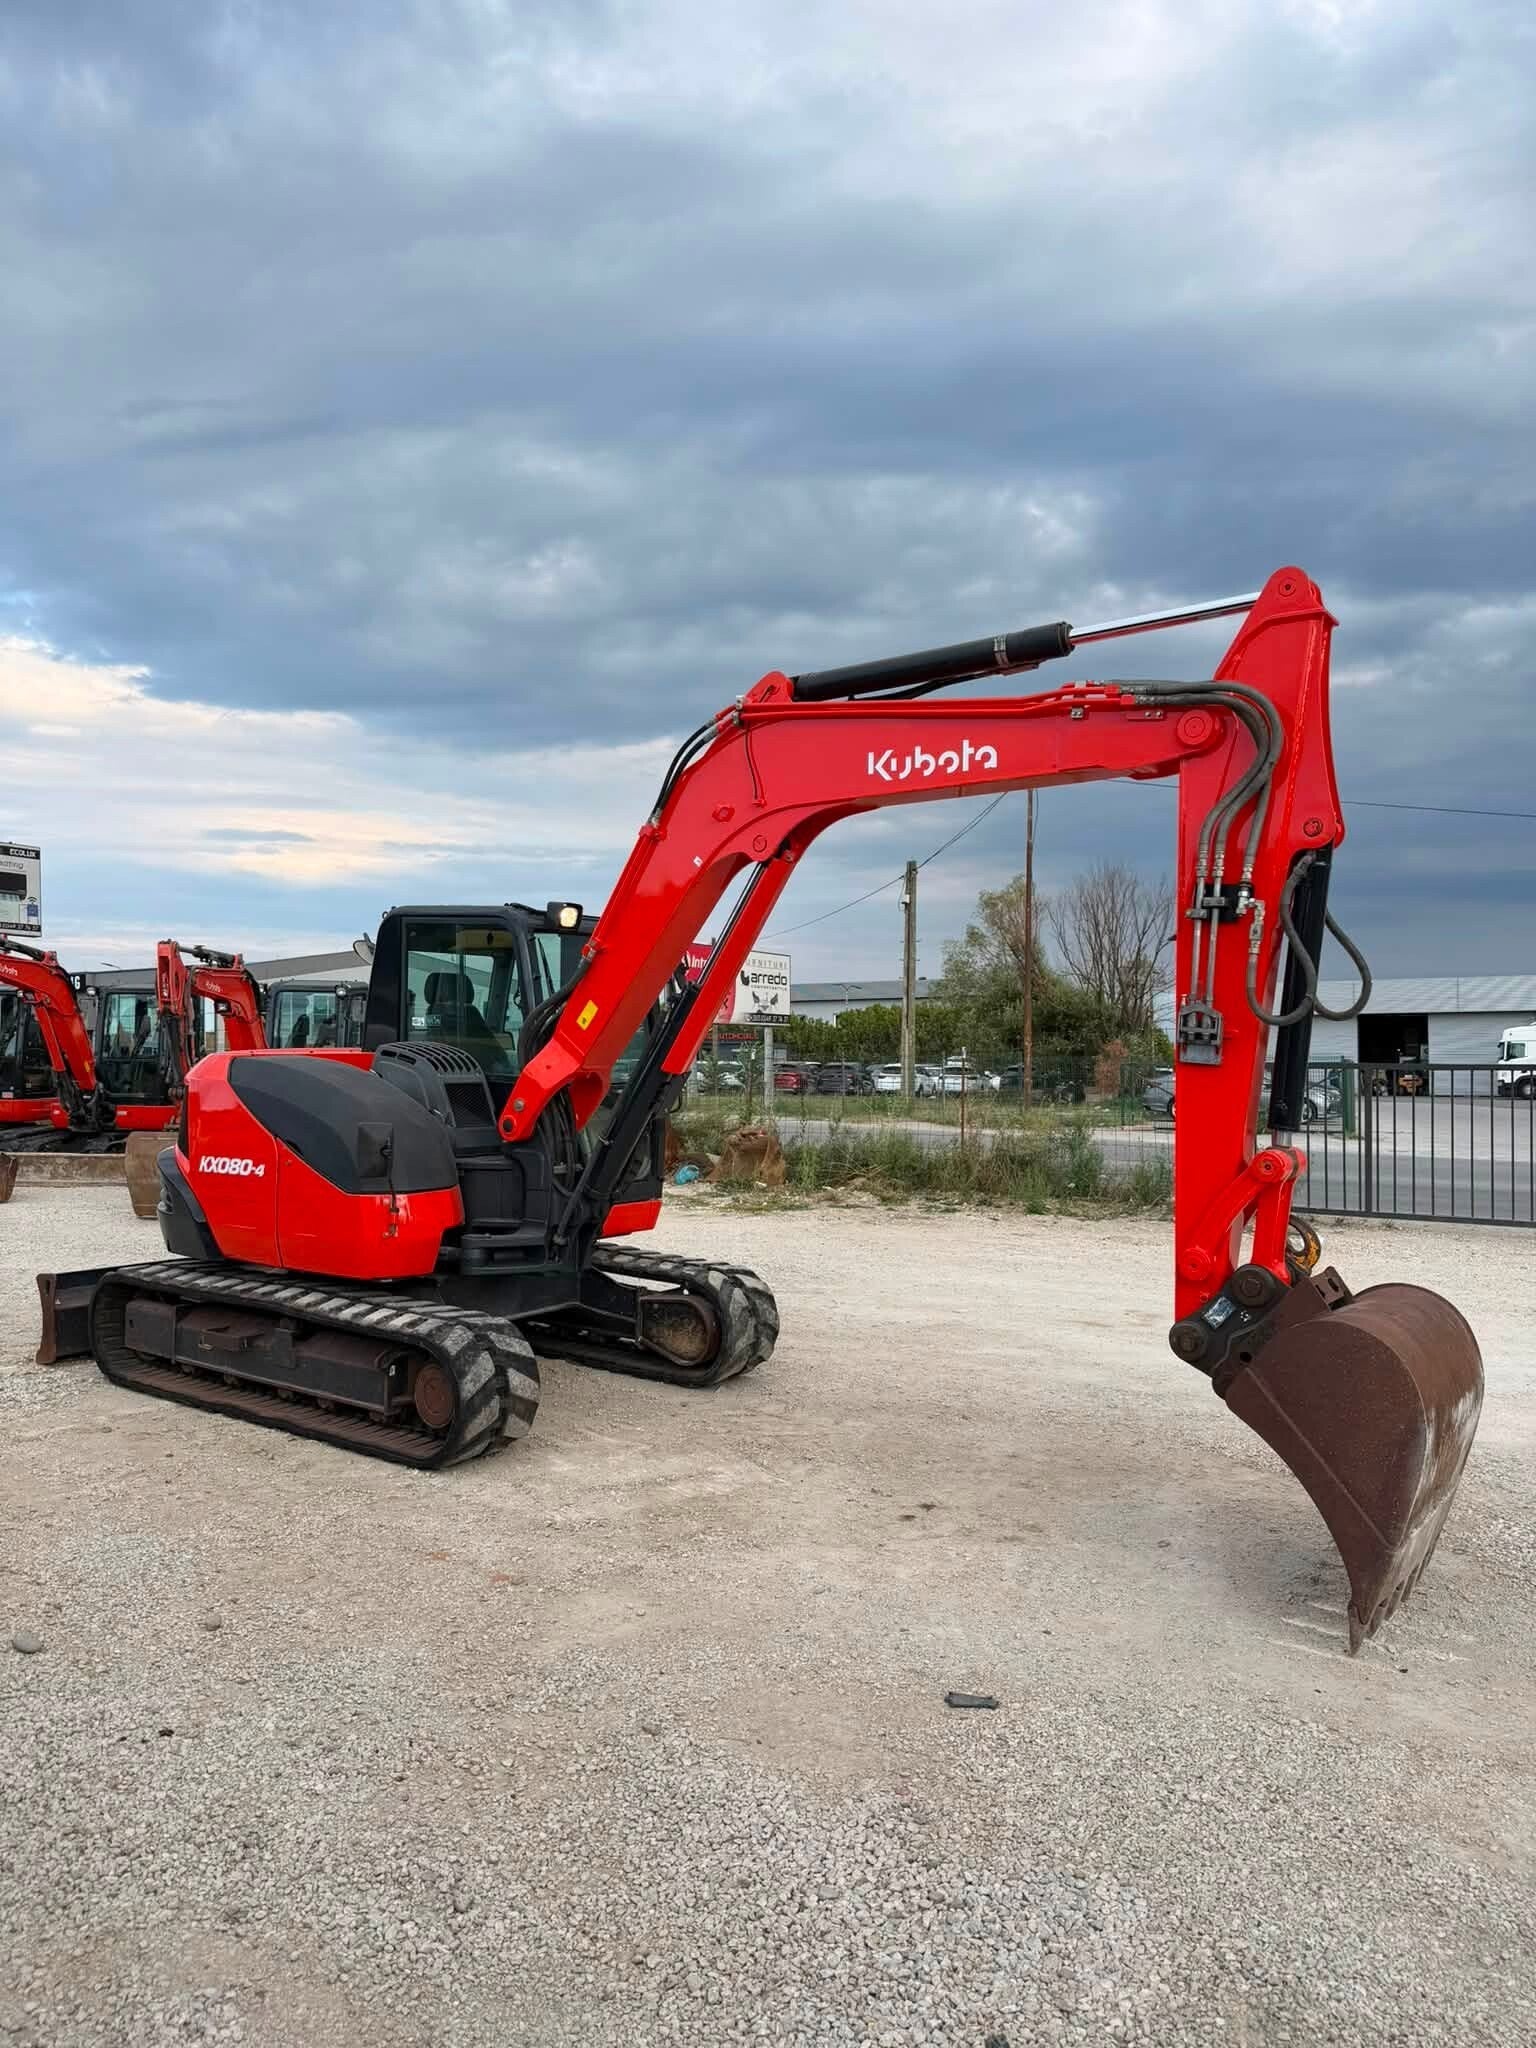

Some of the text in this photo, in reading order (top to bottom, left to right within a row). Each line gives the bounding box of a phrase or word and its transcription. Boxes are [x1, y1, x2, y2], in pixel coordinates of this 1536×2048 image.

[867, 739, 998, 781] Kubota
[751, 973, 787, 986] arredo
[199, 1156, 265, 1177] KX080-4
